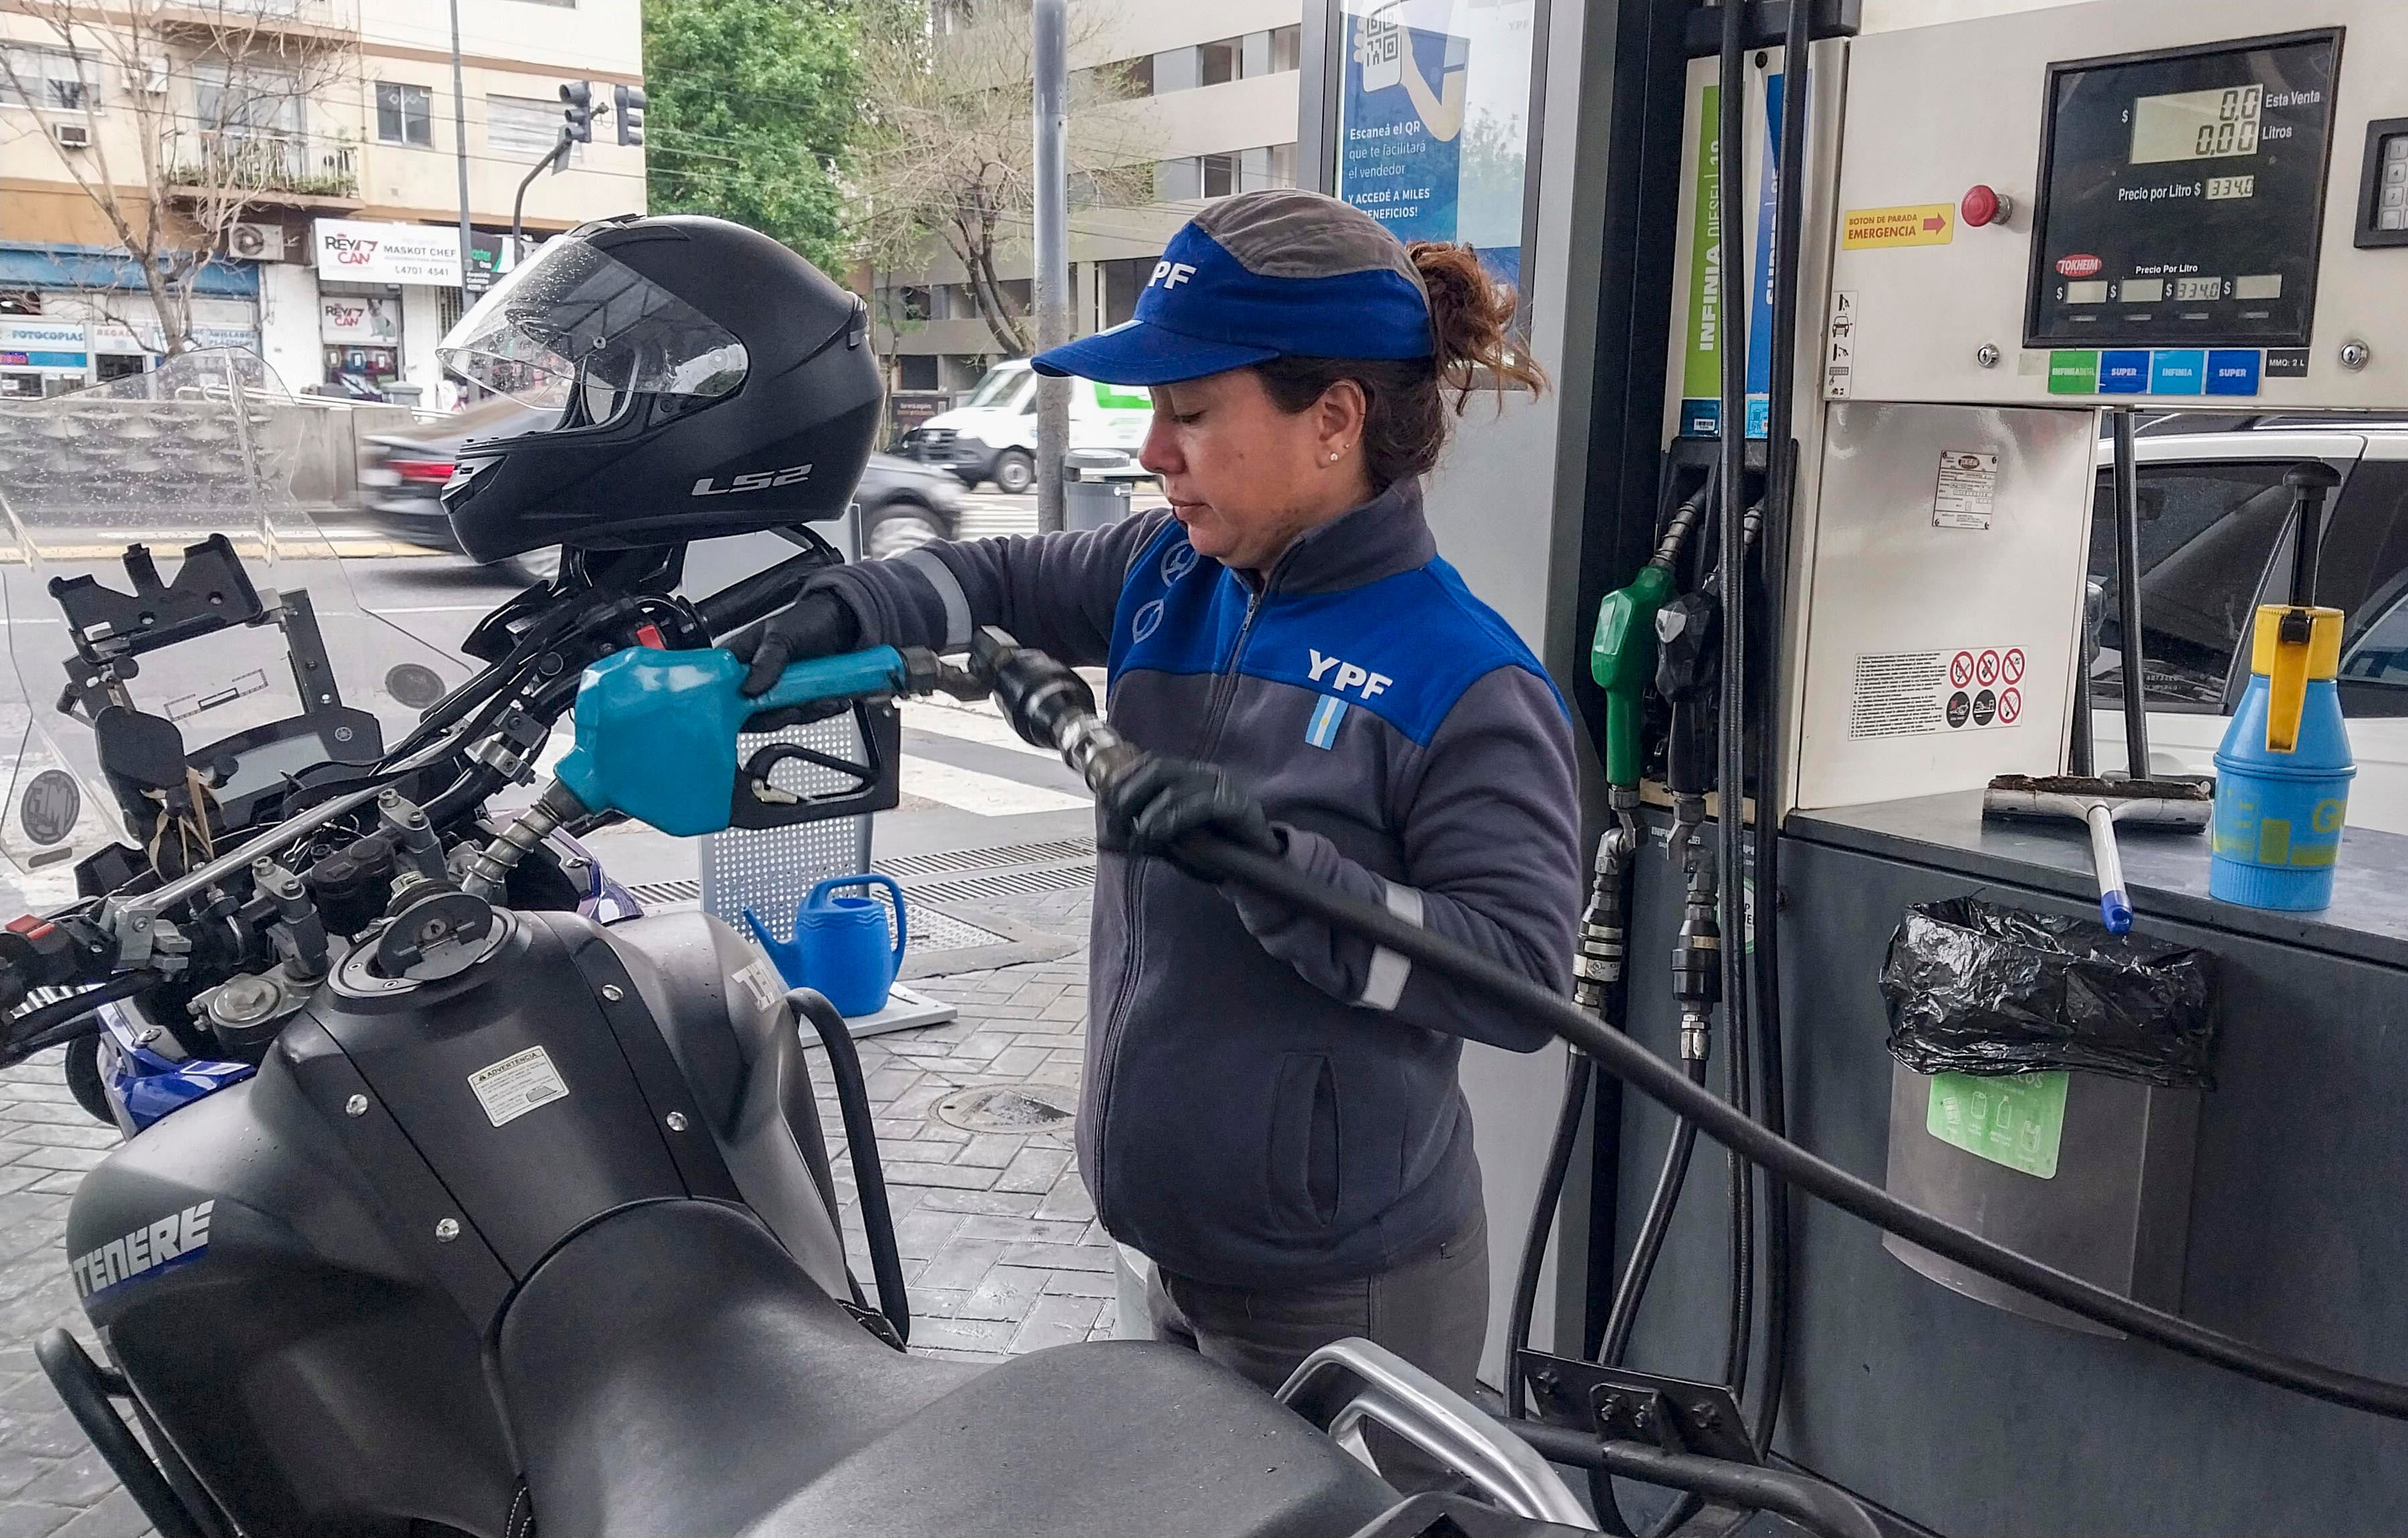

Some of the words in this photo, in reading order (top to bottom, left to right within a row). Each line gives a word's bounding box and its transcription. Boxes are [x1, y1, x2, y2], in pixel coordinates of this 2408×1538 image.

[2266, 94, 2288, 107] Esta
[2291, 90, 2320, 104] Venta
[2122, 110, 2129, 123] $
[1350, 123, 1390, 141] Escaneá
[1394, 122, 1402, 135] el
[1406, 121, 1420, 136] QR
[2263, 127, 2292, 140] Litros
[1349, 149, 1367, 162] que
[1371, 147, 1380, 157] te
[1383, 139, 1426, 155] facilitará
[1349, 167, 1357, 179] el
[1360, 162, 1406, 178] vendedor
[1349, 194, 1353, 204] Y
[1356, 189, 1391, 204] ACCEDÉ
[1394, 190, 1400, 201] A
[1403, 188, 1430, 200] MILES
[2119, 188, 2147, 201] Precio
[2150, 187, 2167, 202] por
[2169, 184, 2192, 198] Litro
[2194, 183, 2202, 197] $
[1849, 216, 1875, 225] BOTON
[1877, 216, 1886, 224] DE
[1887, 214, 1918, 223] PARADA
[1848, 226, 1916, 239] EMERGENCIA
[325, 236, 356, 251] REY
[383, 245, 426, 255] MASKOT
[338, 252, 371, 264] CAN
[2058, 259, 2098, 274] TOKHEIM
[2135, 265, 2161, 275] Precio
[2163, 265, 2178, 274] Por
[2179, 263, 2198, 273] Litro
[1148, 261, 1197, 289] PF
[1700, 241, 1720, 350] INFINIA
[2056, 287, 2063, 300] $
[2110, 284, 2117, 299] $
[2165, 283, 2172, 297] $
[2224, 281, 2230, 295] $
[12, 330, 83, 341] FOTOCOPIAS
[2111, 368, 2137, 376] SUPER
[2219, 368, 2247, 377] SUPER
[692, 464, 813, 496] LS2
[1308, 648, 1393, 699] YPF
[487, 1052, 537, 1077] ADVERTENCIA
